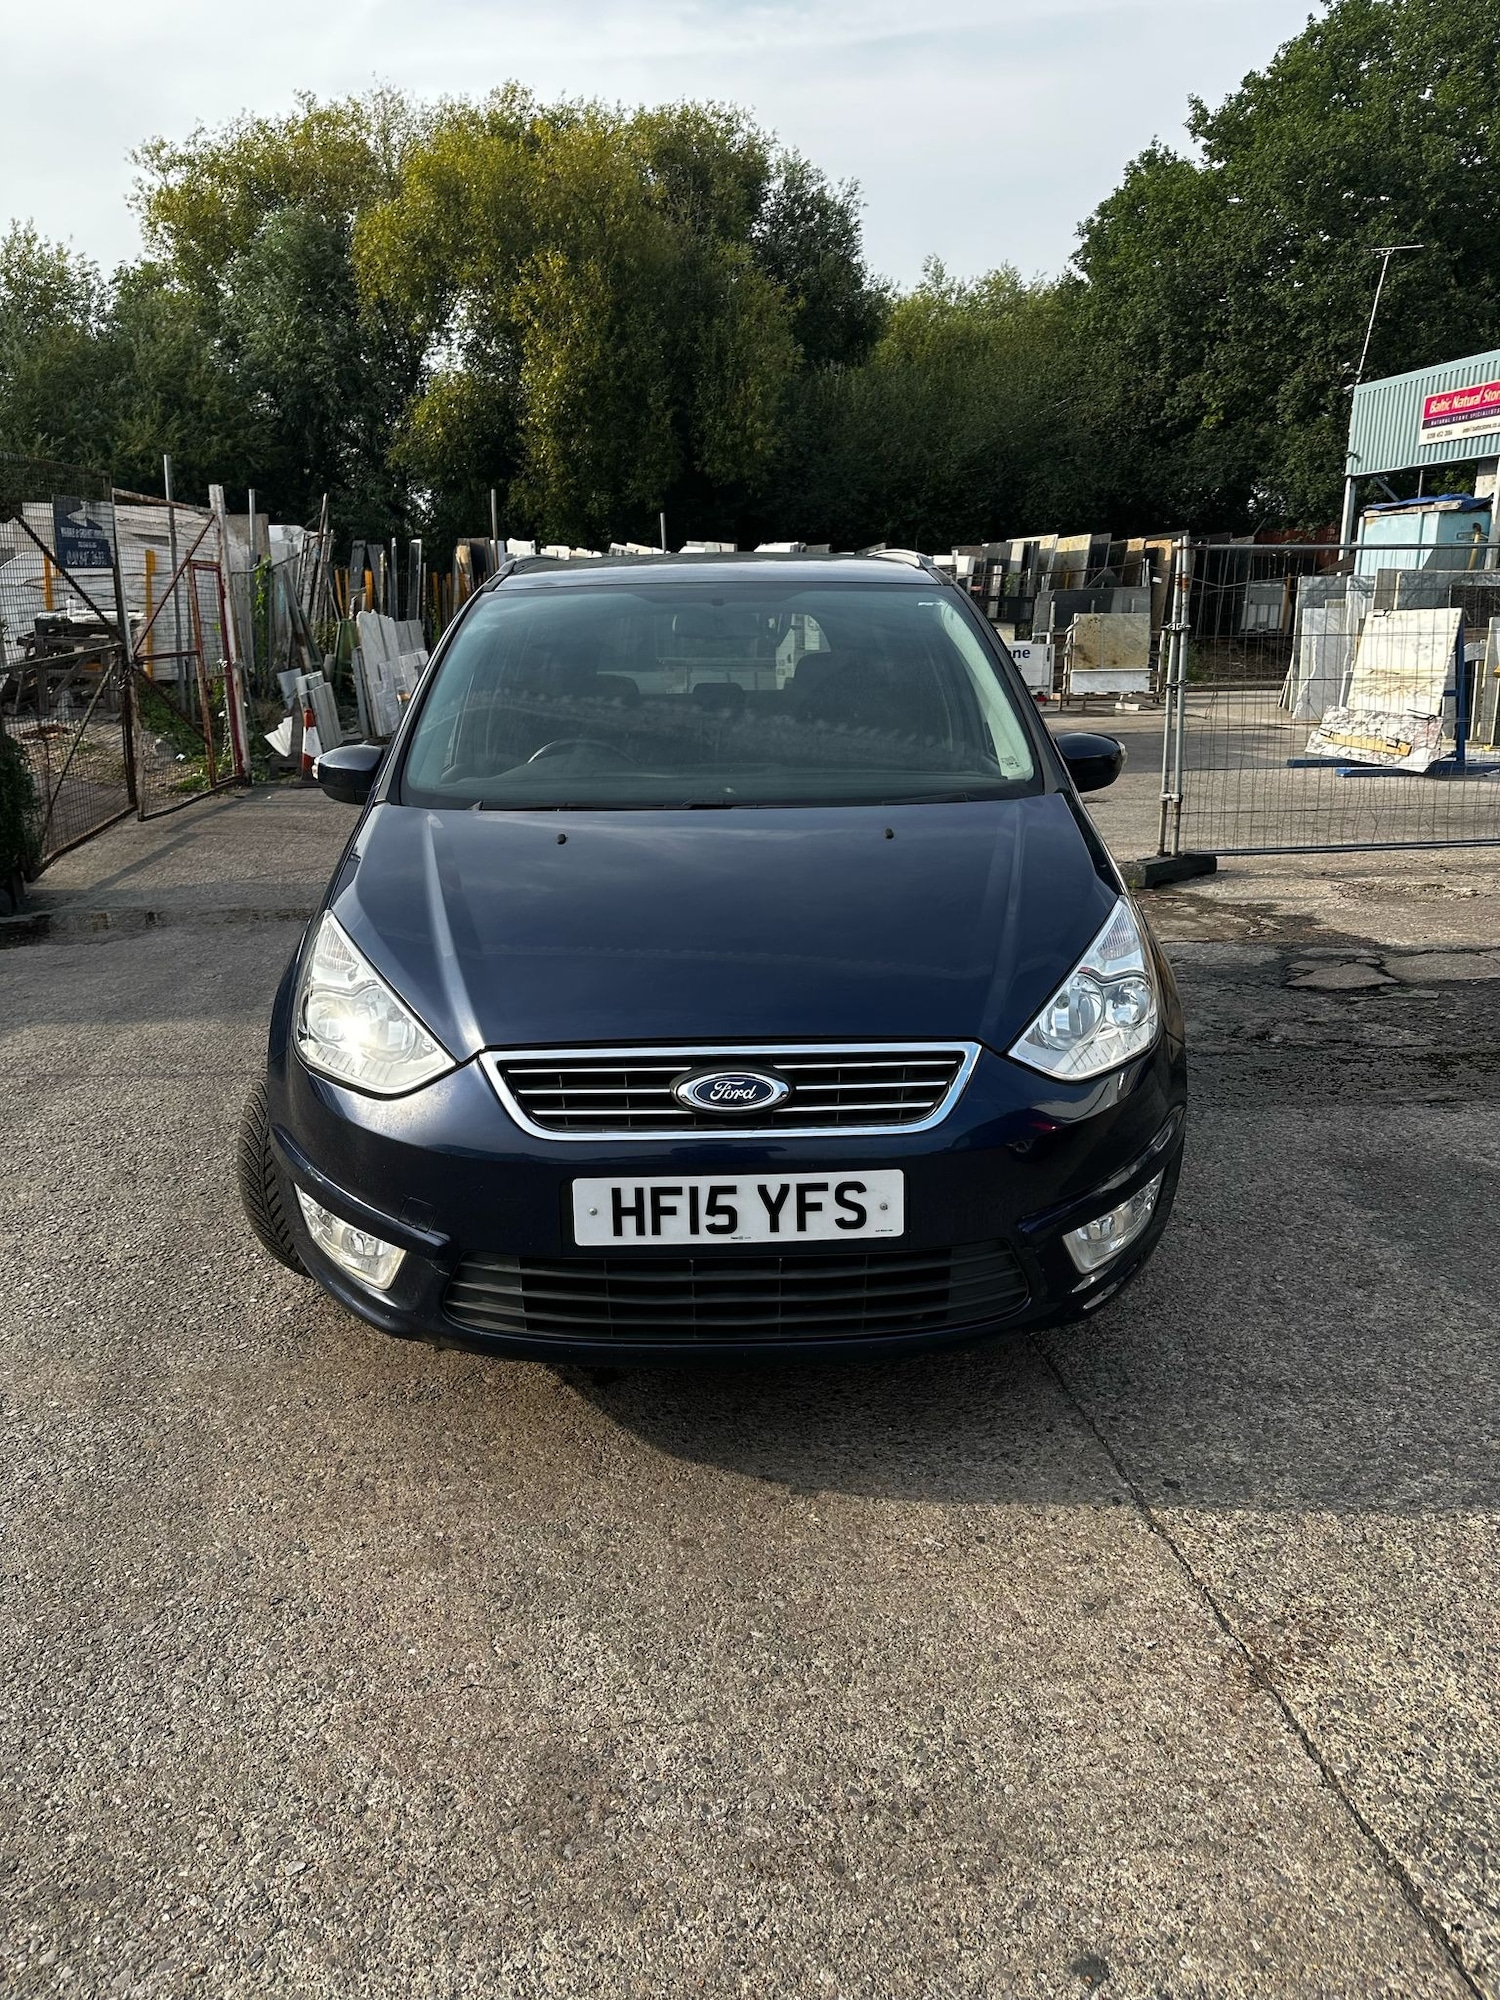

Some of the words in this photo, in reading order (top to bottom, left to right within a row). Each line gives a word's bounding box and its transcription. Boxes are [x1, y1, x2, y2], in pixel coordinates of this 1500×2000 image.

[1429, 398, 1452, 415] Baltic
[1452, 385, 1485, 409] Natural
[1430, 418, 1451, 426] NATURAL
[1452, 414, 1468, 423] STONE
[1010, 648, 1031, 659] ne
[709, 1080, 757, 1101] Ford
[611, 1185, 738, 1237] HF15
[757, 1181, 867, 1233] YFS
